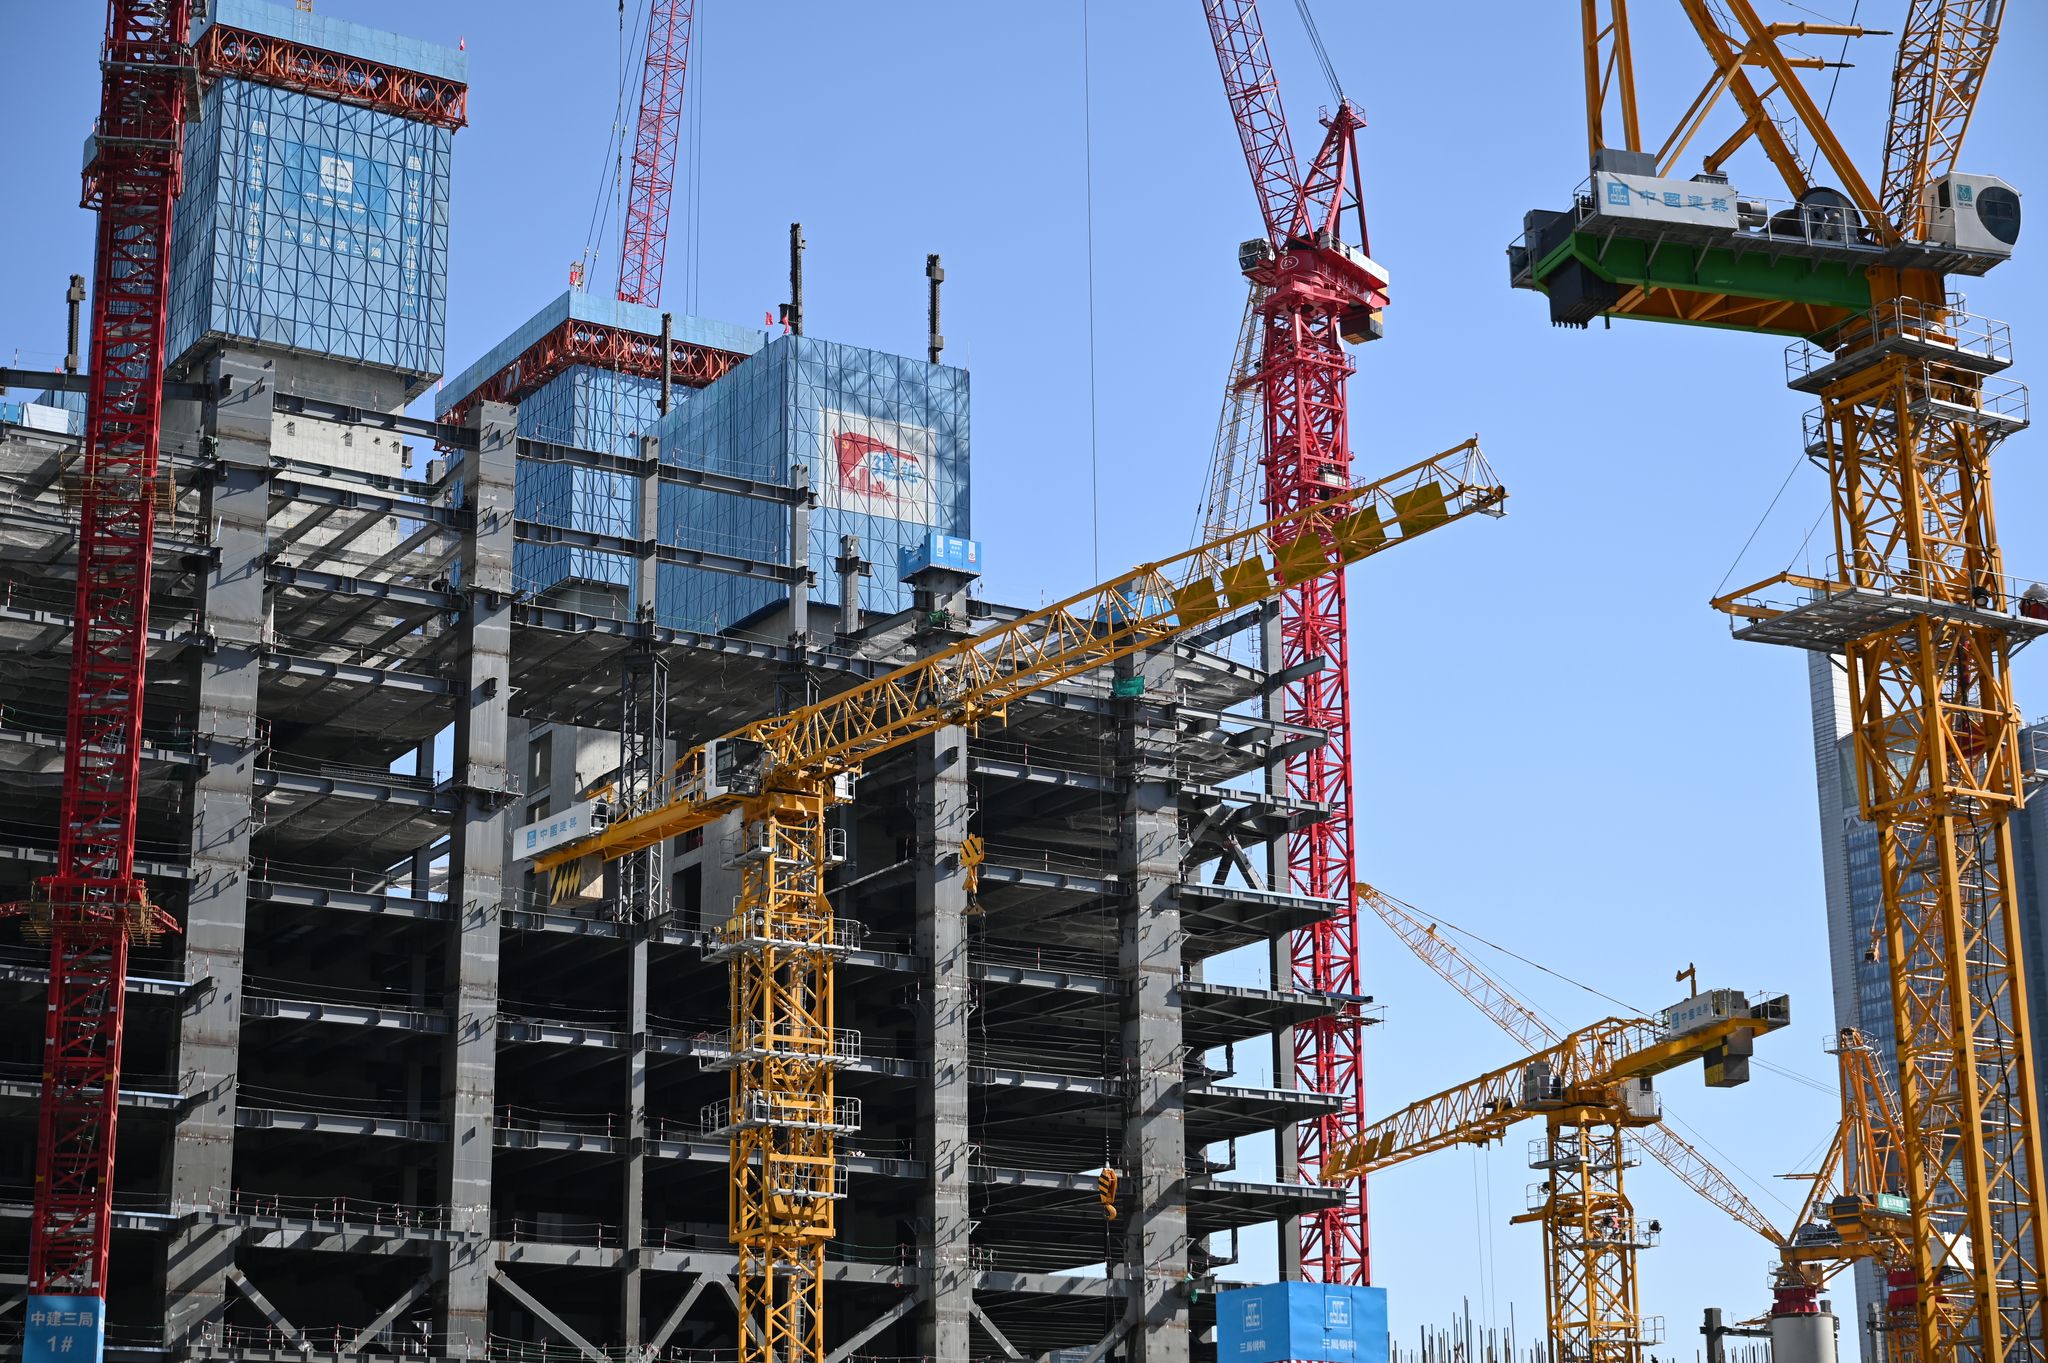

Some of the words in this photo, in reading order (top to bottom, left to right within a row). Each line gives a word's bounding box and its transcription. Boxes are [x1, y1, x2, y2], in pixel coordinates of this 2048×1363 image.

[31, 1311, 93, 1327] 中建三局
[48, 1335, 73, 1352] 1#
